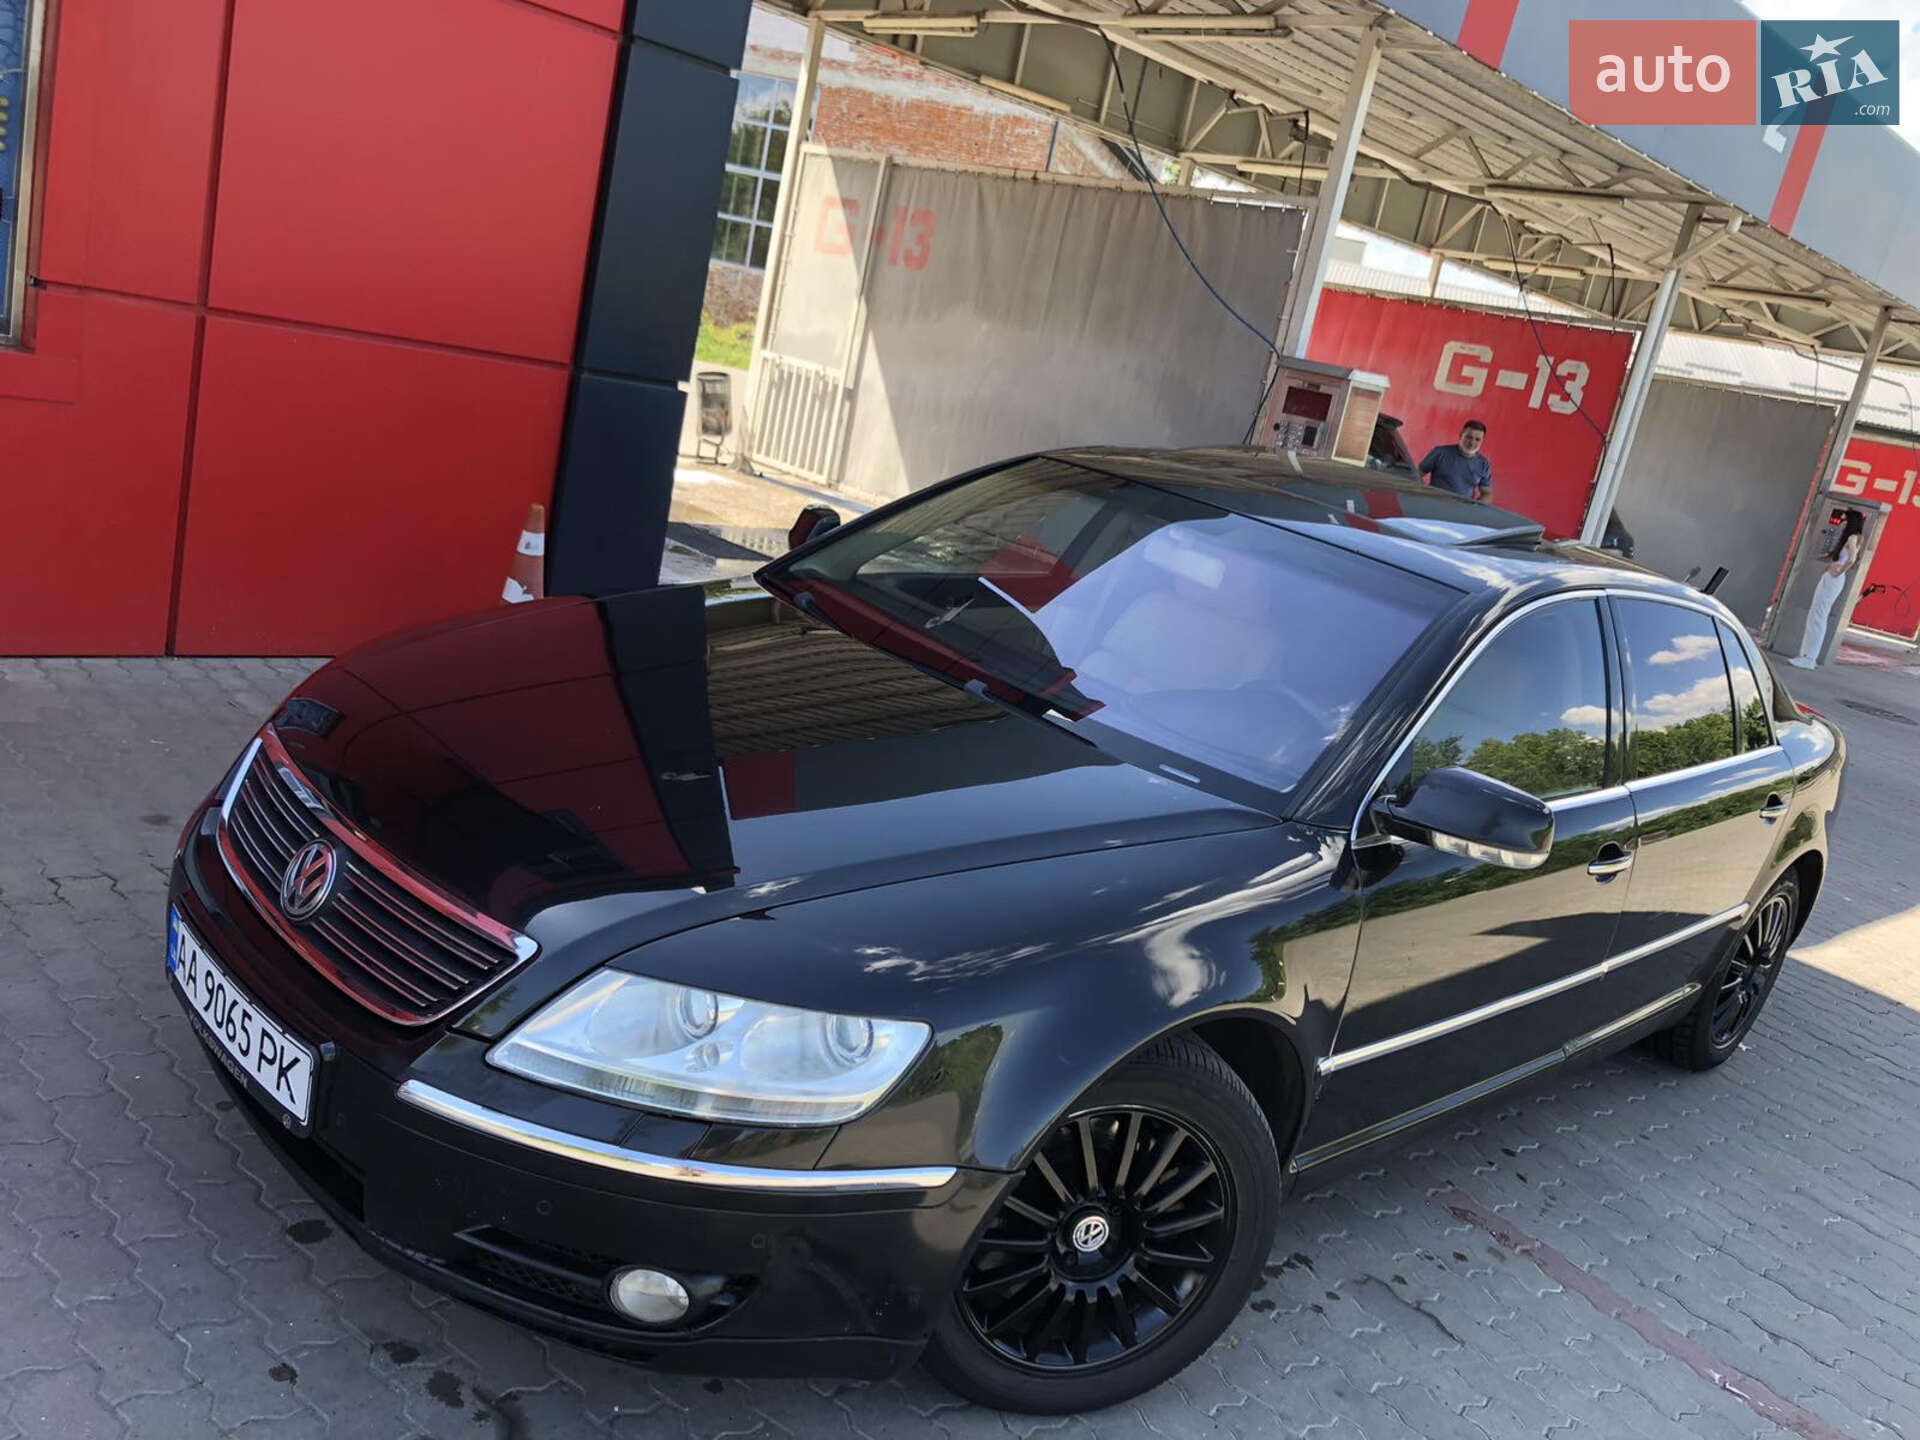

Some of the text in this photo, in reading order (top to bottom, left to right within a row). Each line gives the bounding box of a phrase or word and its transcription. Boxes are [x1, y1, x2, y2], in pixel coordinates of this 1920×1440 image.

[1433, 341, 1590, 415] G-13
[1829, 459, 1920, 508] G-1
[177, 935, 301, 1105] AA 9065 PK
